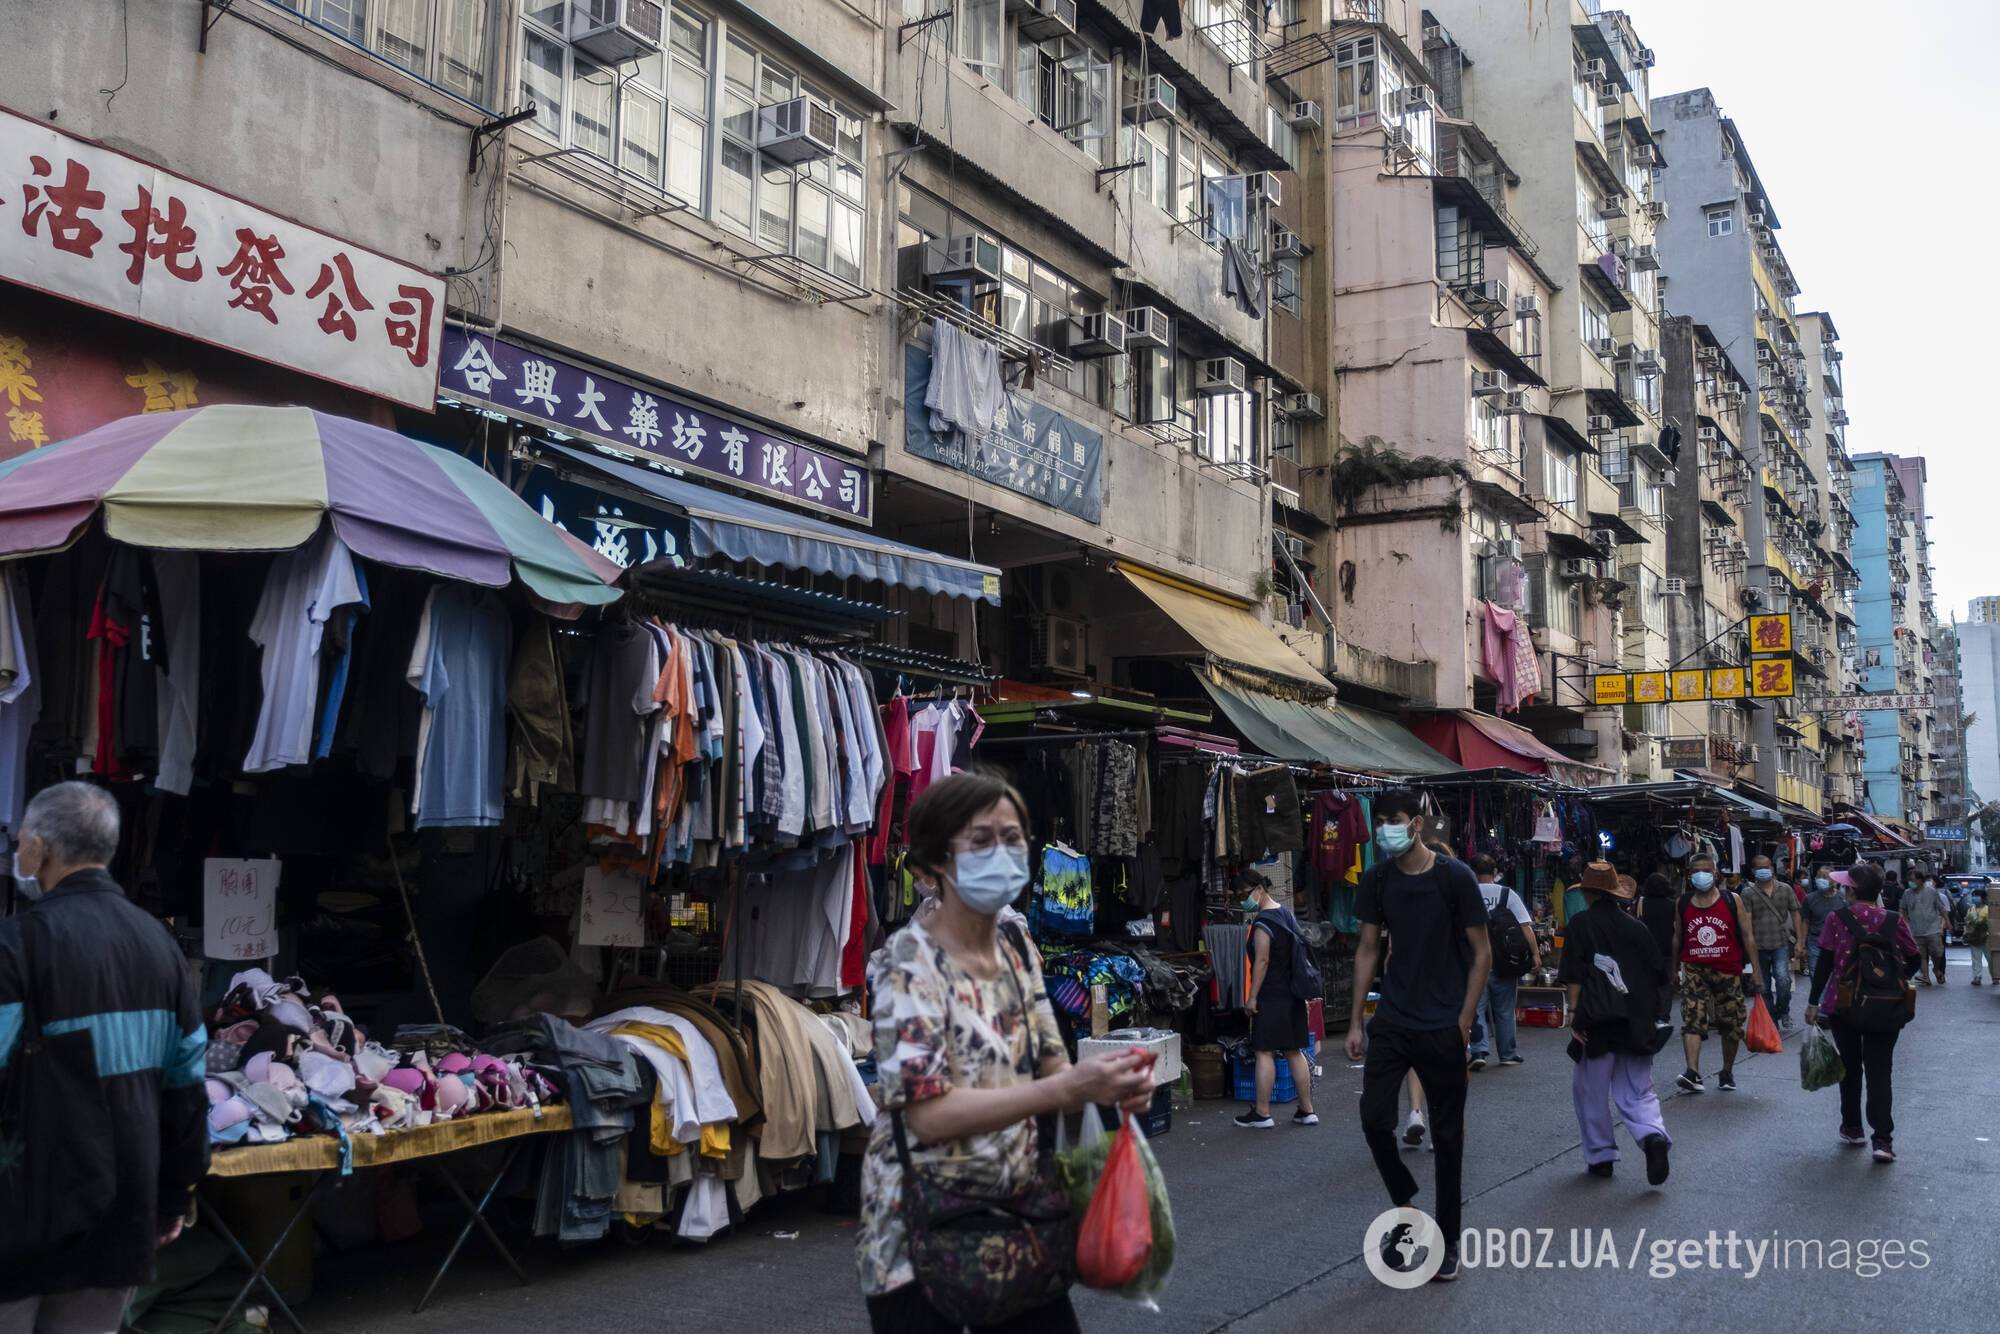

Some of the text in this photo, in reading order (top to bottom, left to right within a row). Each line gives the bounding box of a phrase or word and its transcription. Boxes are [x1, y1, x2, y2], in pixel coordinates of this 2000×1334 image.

[452, 338, 863, 519] 合興大藥坊有限公司
[1755, 619, 1789, 693] 禮記
[1687, 916, 1729, 933] NEW YORK
[1689, 946, 1729, 956] UNIVERSITY
